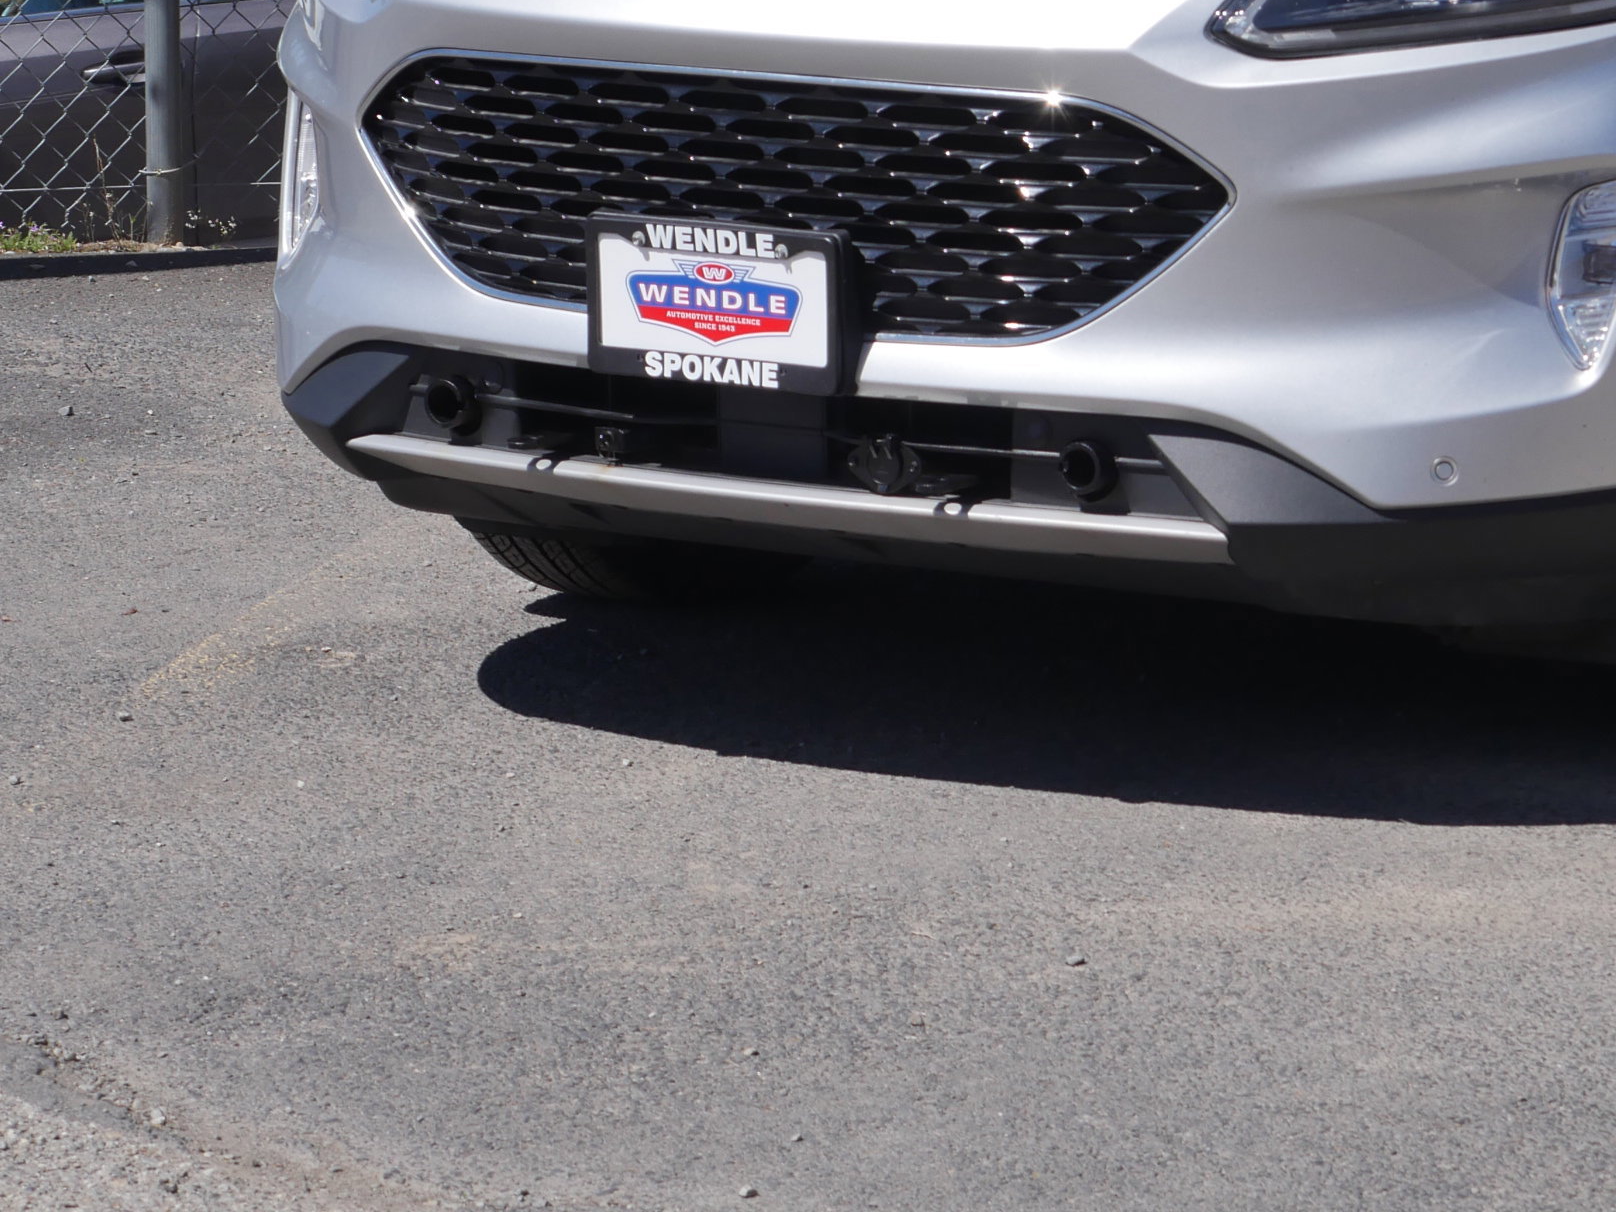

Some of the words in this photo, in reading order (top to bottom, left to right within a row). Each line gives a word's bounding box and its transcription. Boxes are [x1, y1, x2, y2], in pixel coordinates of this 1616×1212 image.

[645, 223, 776, 259] WENDLE
[638, 283, 786, 314] WENDLE
[666, 310, 713, 322] AUTOMOTIVE
[715, 315, 761, 326] EXCELLENCE
[694, 321, 717, 331] SINCE
[718, 324, 736, 333] 1943
[644, 350, 779, 389] SPOKANE
